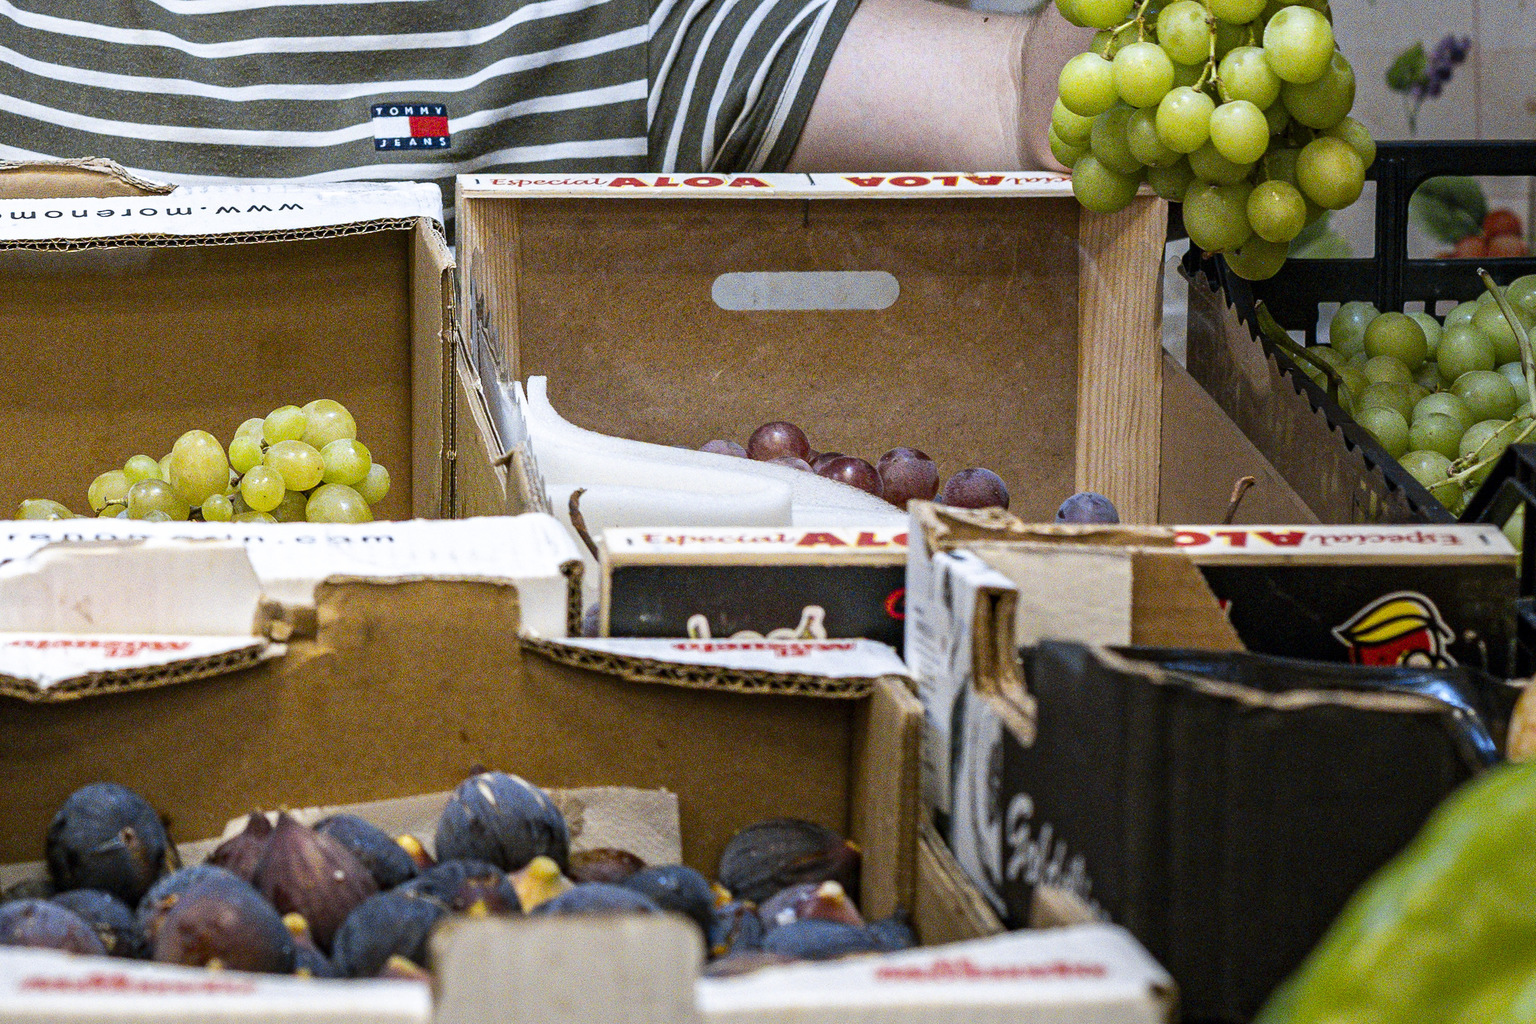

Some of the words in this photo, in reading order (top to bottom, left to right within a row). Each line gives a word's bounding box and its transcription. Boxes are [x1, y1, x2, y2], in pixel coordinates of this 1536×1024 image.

[375, 106, 442, 116] TOMMY
[379, 136, 447, 148] JEANS
[607, 176, 775, 189] ALOA
[840, 175, 1007, 188] ALOA
[1174, 529, 1307, 548] ALO
